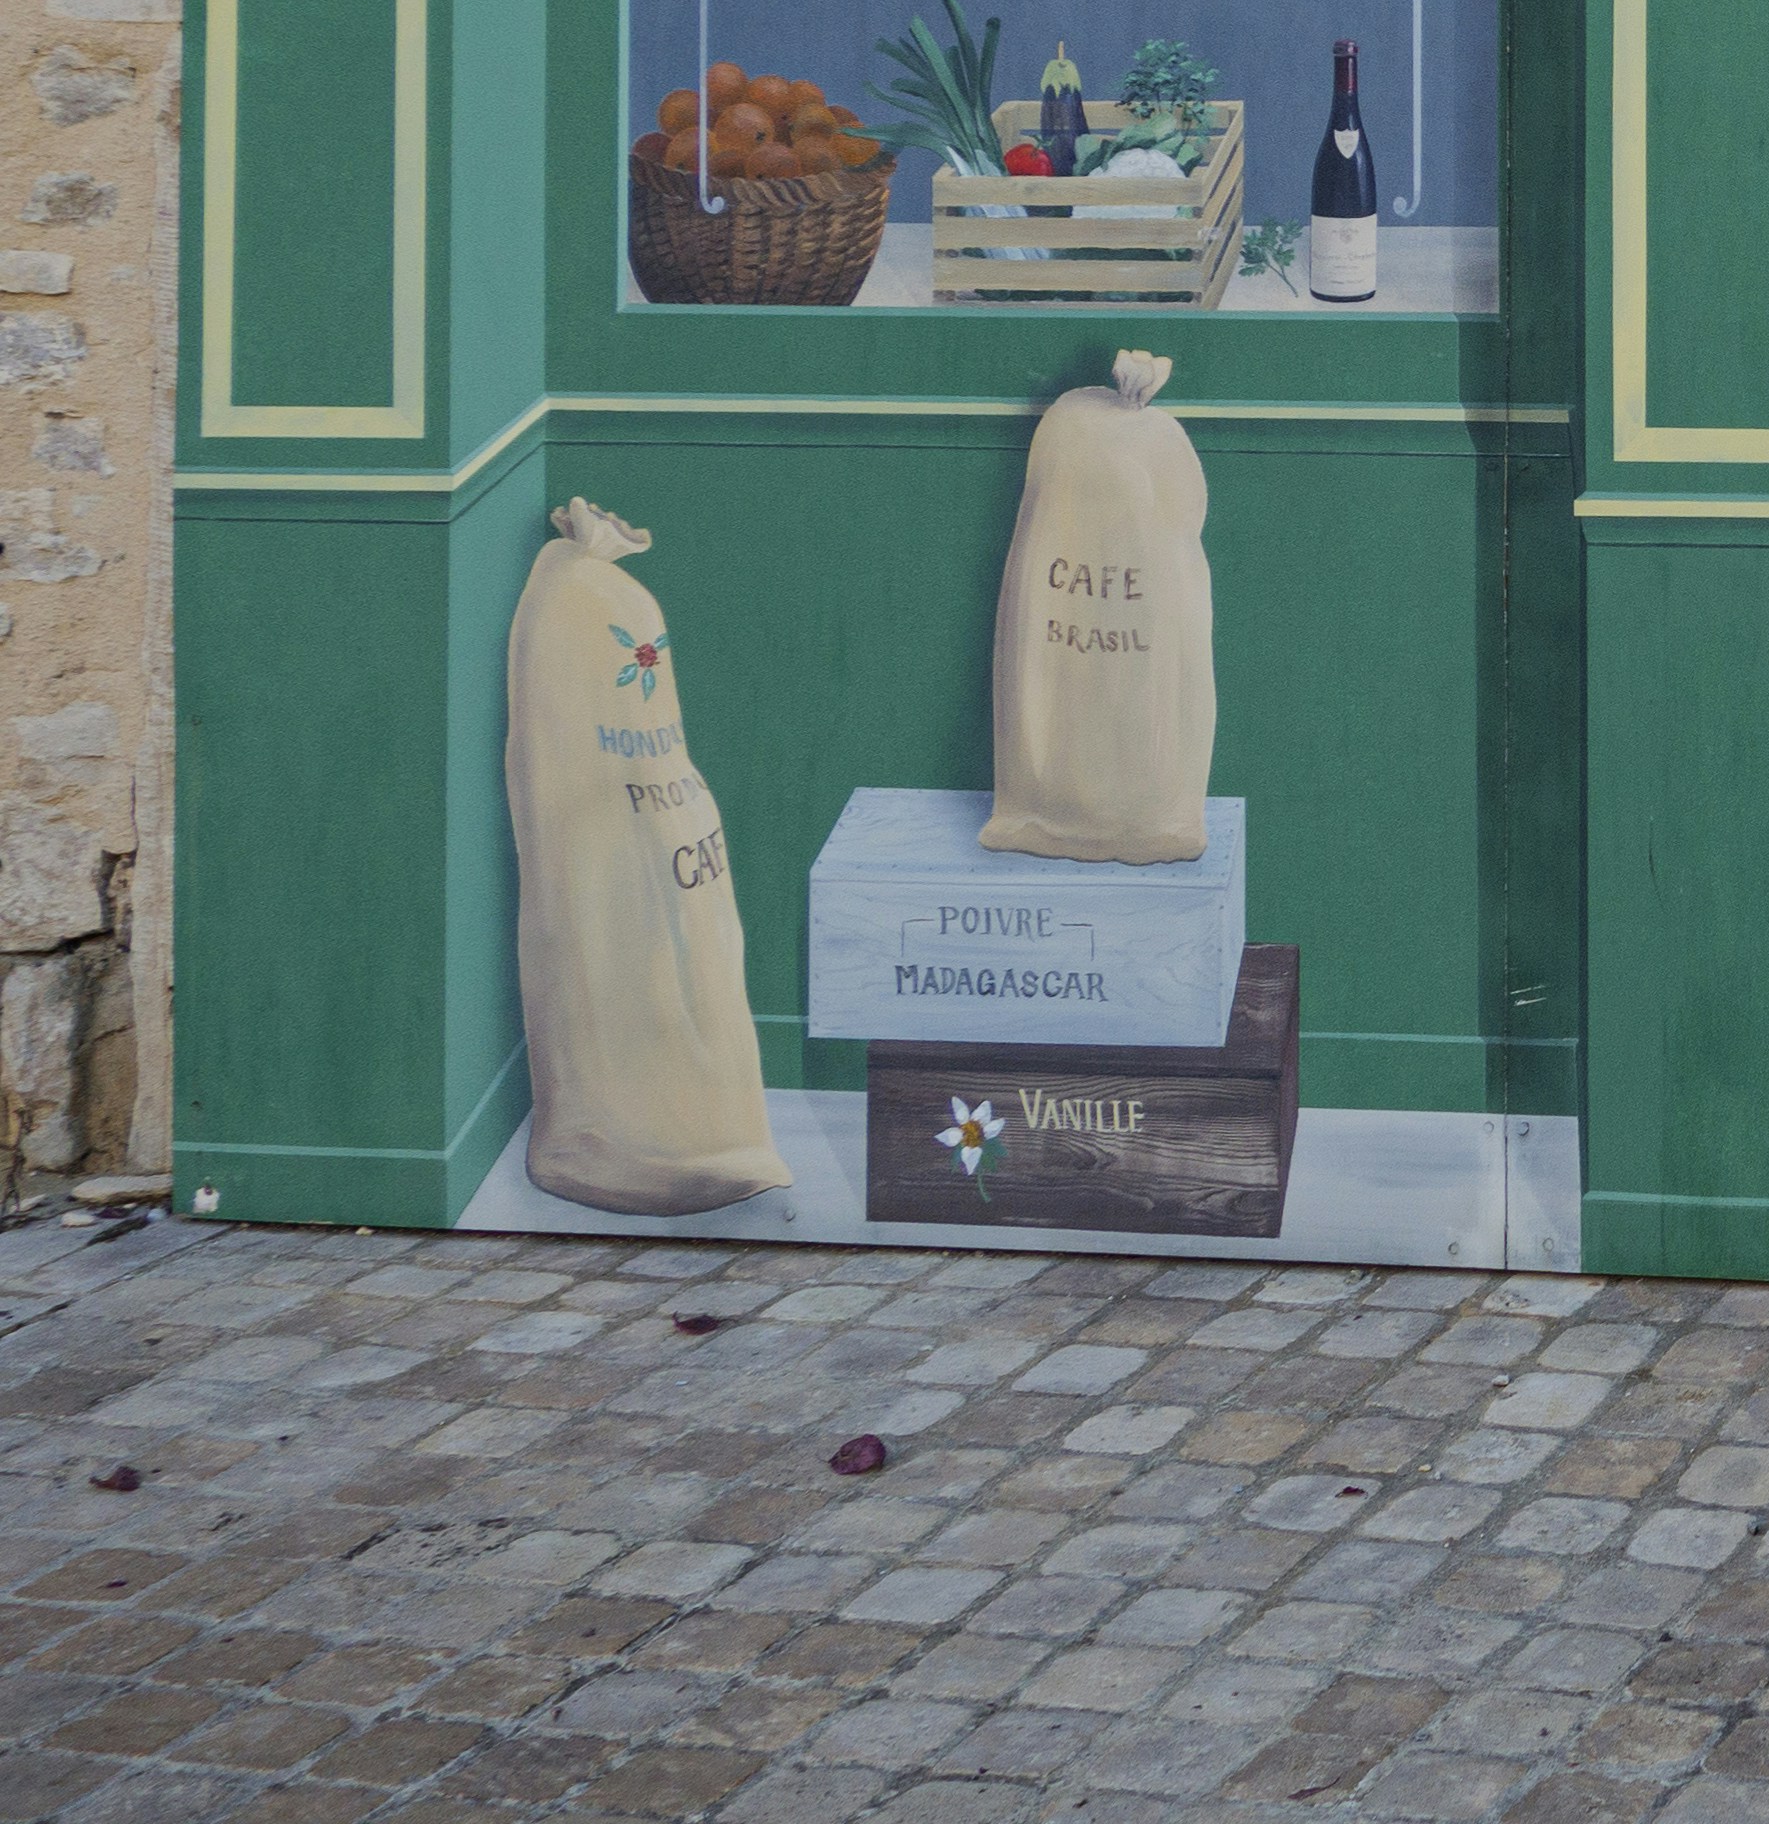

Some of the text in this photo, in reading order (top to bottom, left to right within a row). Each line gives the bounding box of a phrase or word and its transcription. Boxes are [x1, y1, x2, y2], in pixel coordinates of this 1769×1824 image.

[1048, 557, 1144, 601] CAFE
[1047, 619, 1152, 654] BRASIL
[937, 905, 1054, 943] POIVRE
[894, 964, 1110, 1003] MADAGASCAR
